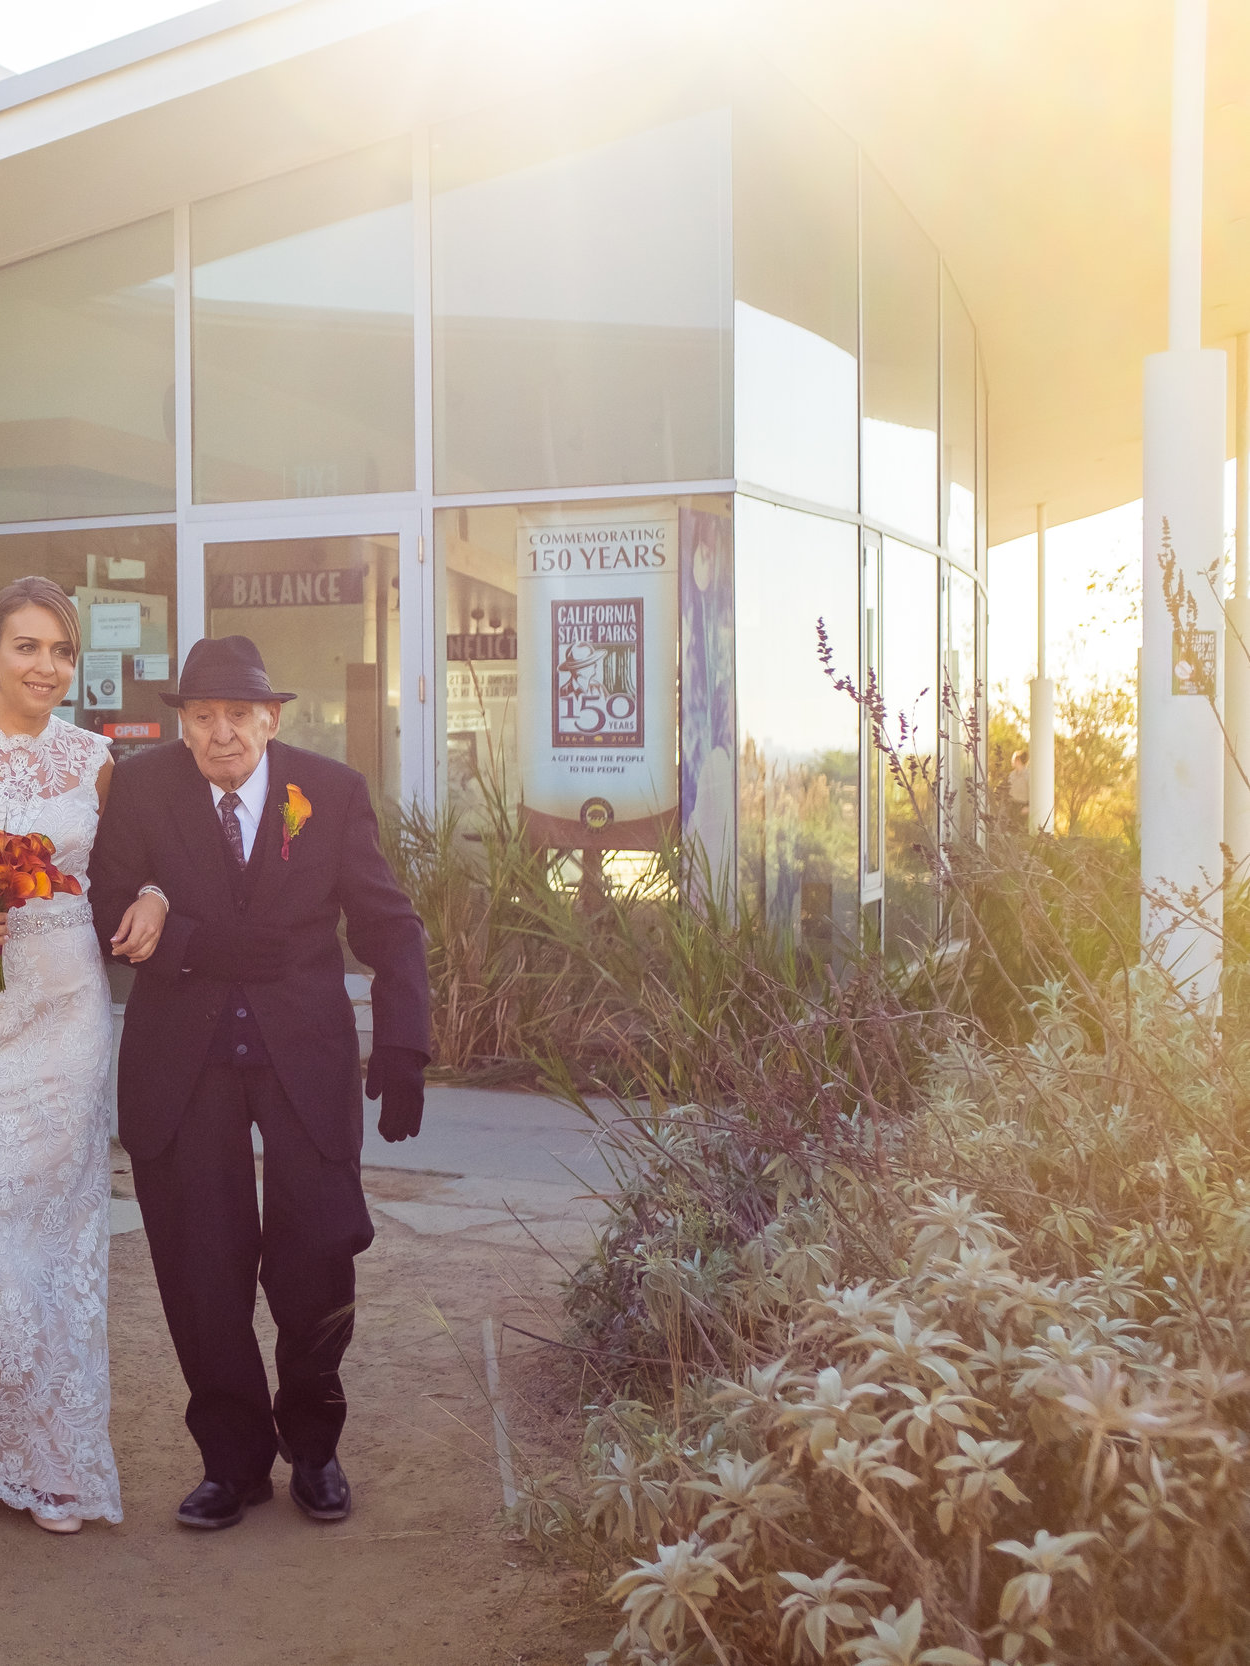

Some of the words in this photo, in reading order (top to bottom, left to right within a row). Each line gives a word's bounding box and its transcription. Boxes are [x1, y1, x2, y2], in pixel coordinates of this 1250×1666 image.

[529, 527, 665, 545] COMMEMORATING
[527, 548, 572, 572] 150
[579, 543, 666, 570] YEARS
[232, 571, 342, 606] BALANCE
[557, 604, 637, 625] CALIFORNIA
[558, 625, 593, 643] STATE
[598, 623, 637, 642] PARKS
[560, 694, 636, 734] 150
[114, 725, 149, 737] OPEN
[608, 721, 635, 730] YEARS
